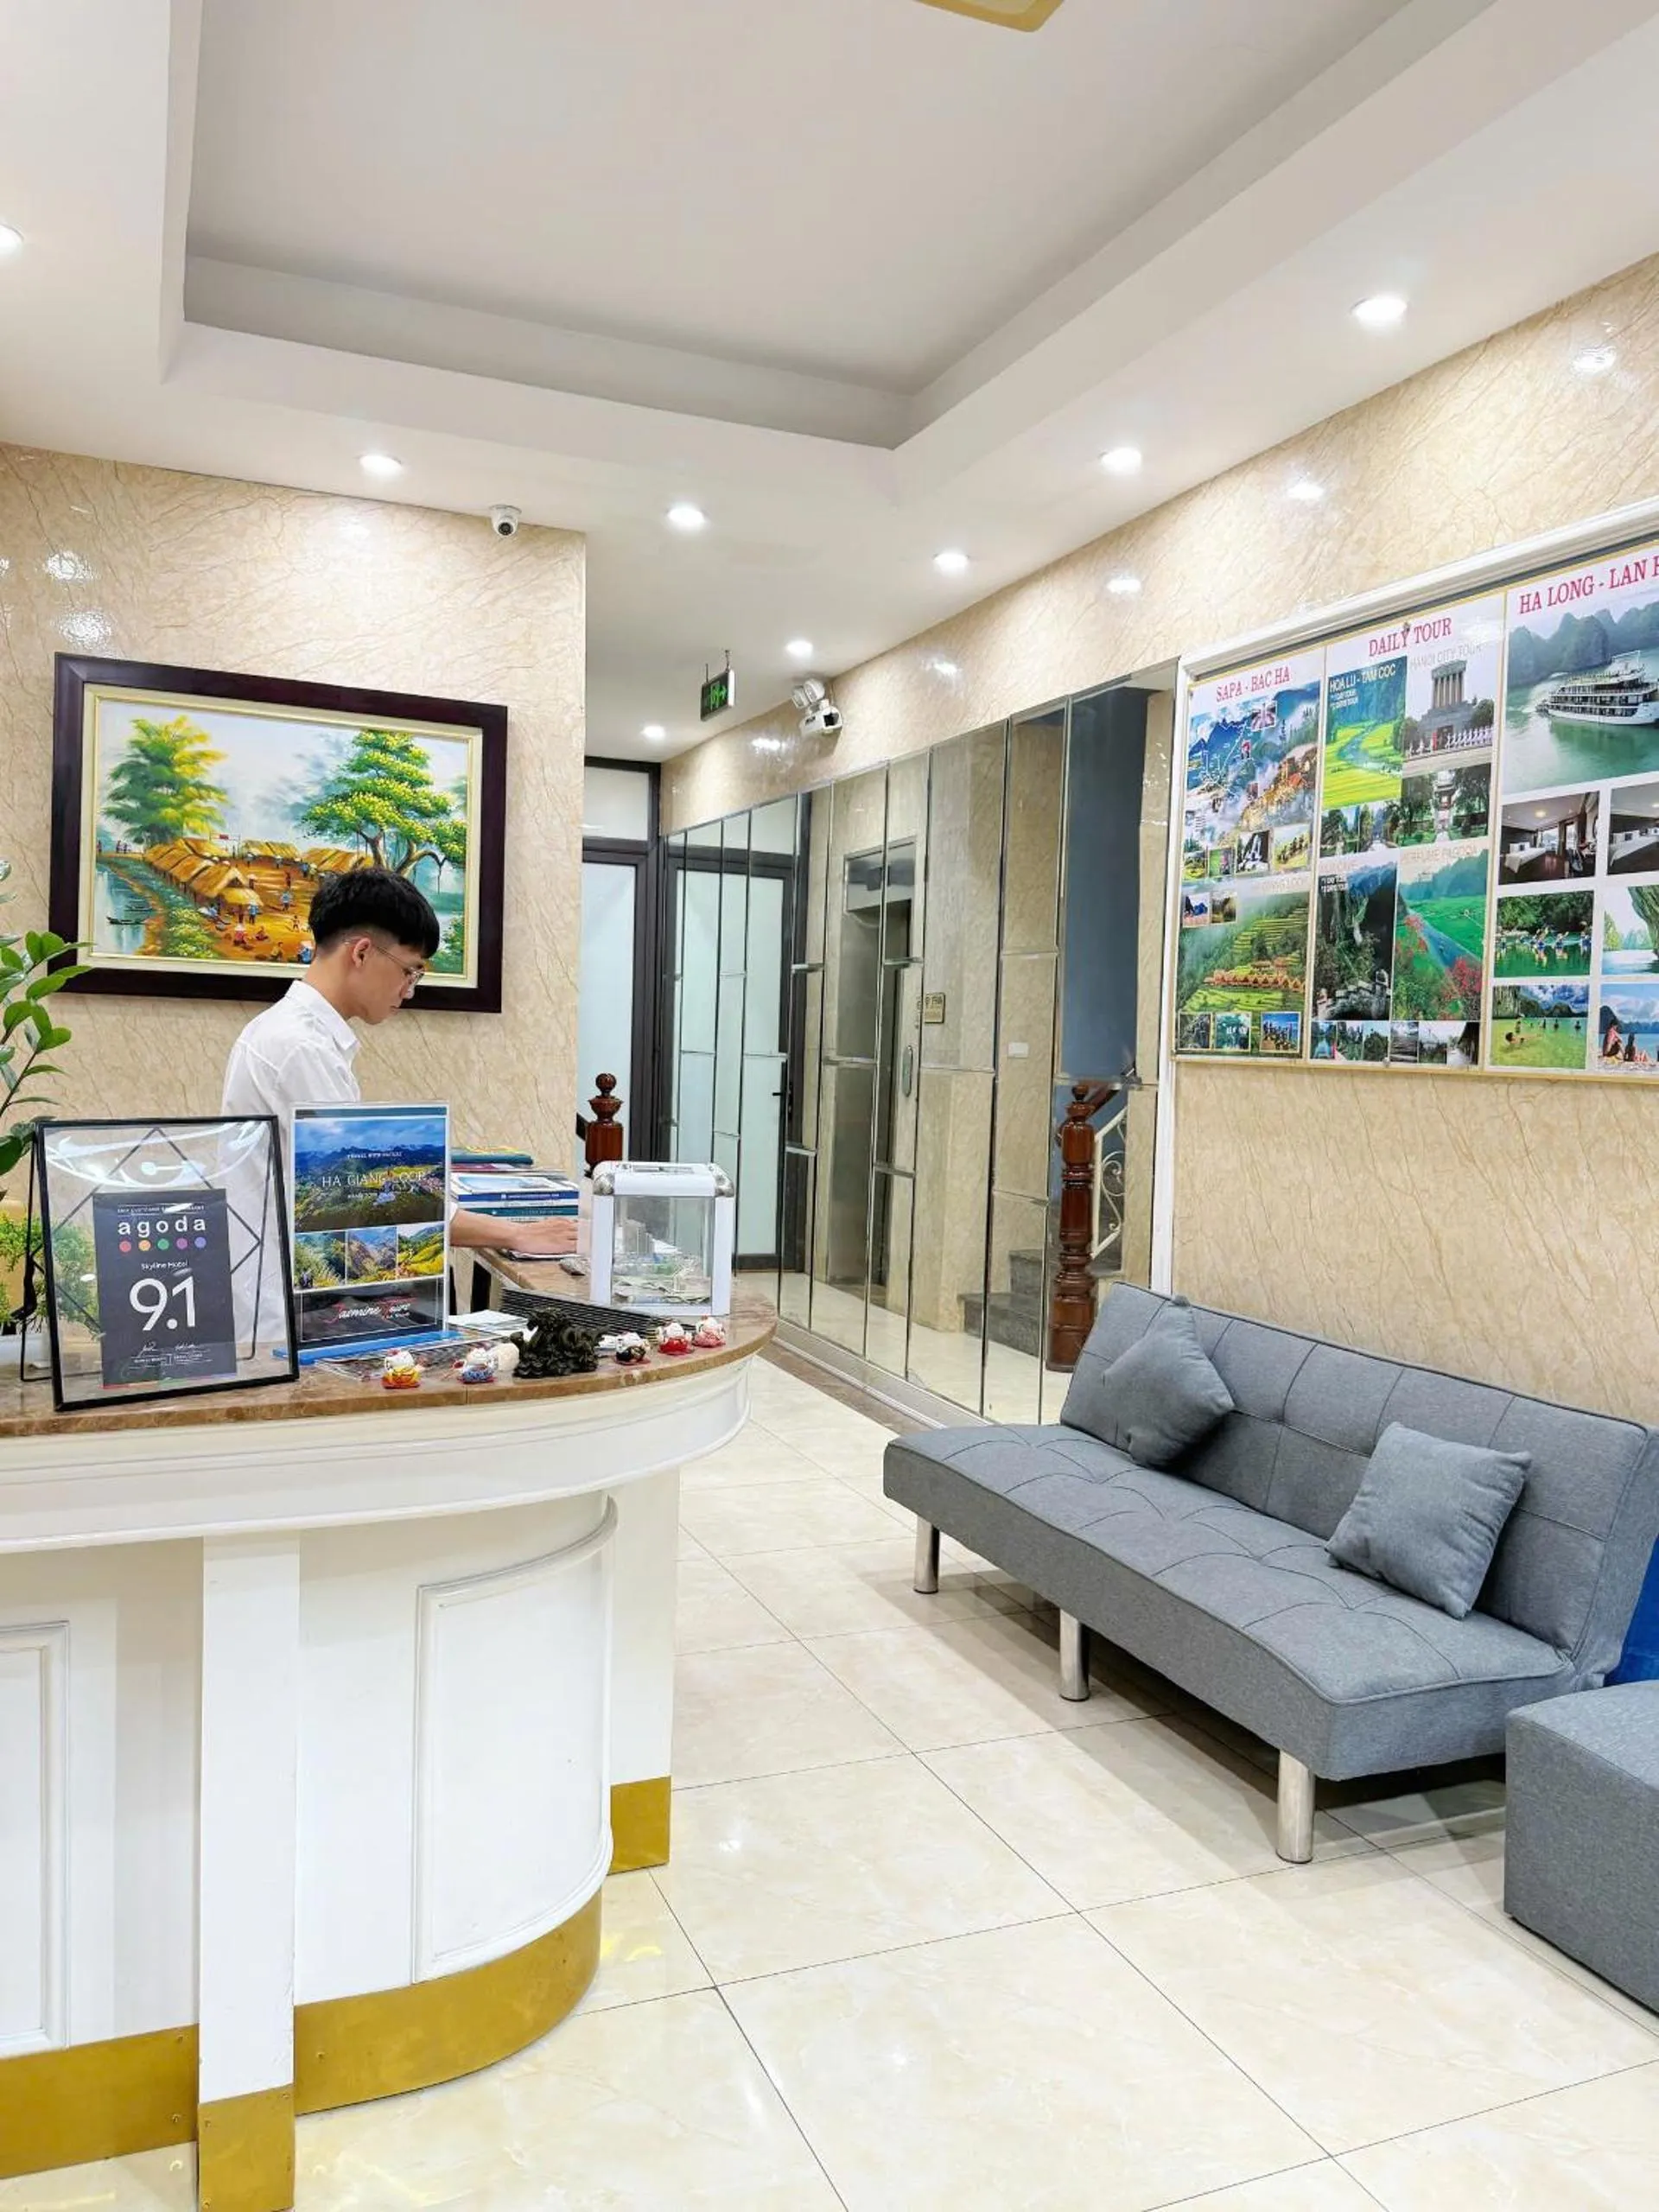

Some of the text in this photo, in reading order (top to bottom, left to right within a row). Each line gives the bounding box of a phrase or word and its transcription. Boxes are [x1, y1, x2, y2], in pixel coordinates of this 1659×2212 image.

[1520, 591, 1541, 614] HA
[1548, 575, 1594, 607] LONG
[1608, 559, 1647, 589] LAN
[1369, 617, 1452, 657] DAILY TOUR
[1216, 682, 1243, 702] SAPA
[1250, 671, 1273, 692] BAC
[1274, 666, 1290, 686] HA
[322, 1175, 341, 1187] HA
[118, 1216, 207, 1237] agoda
[130, 1275, 196, 1331] 9.1
